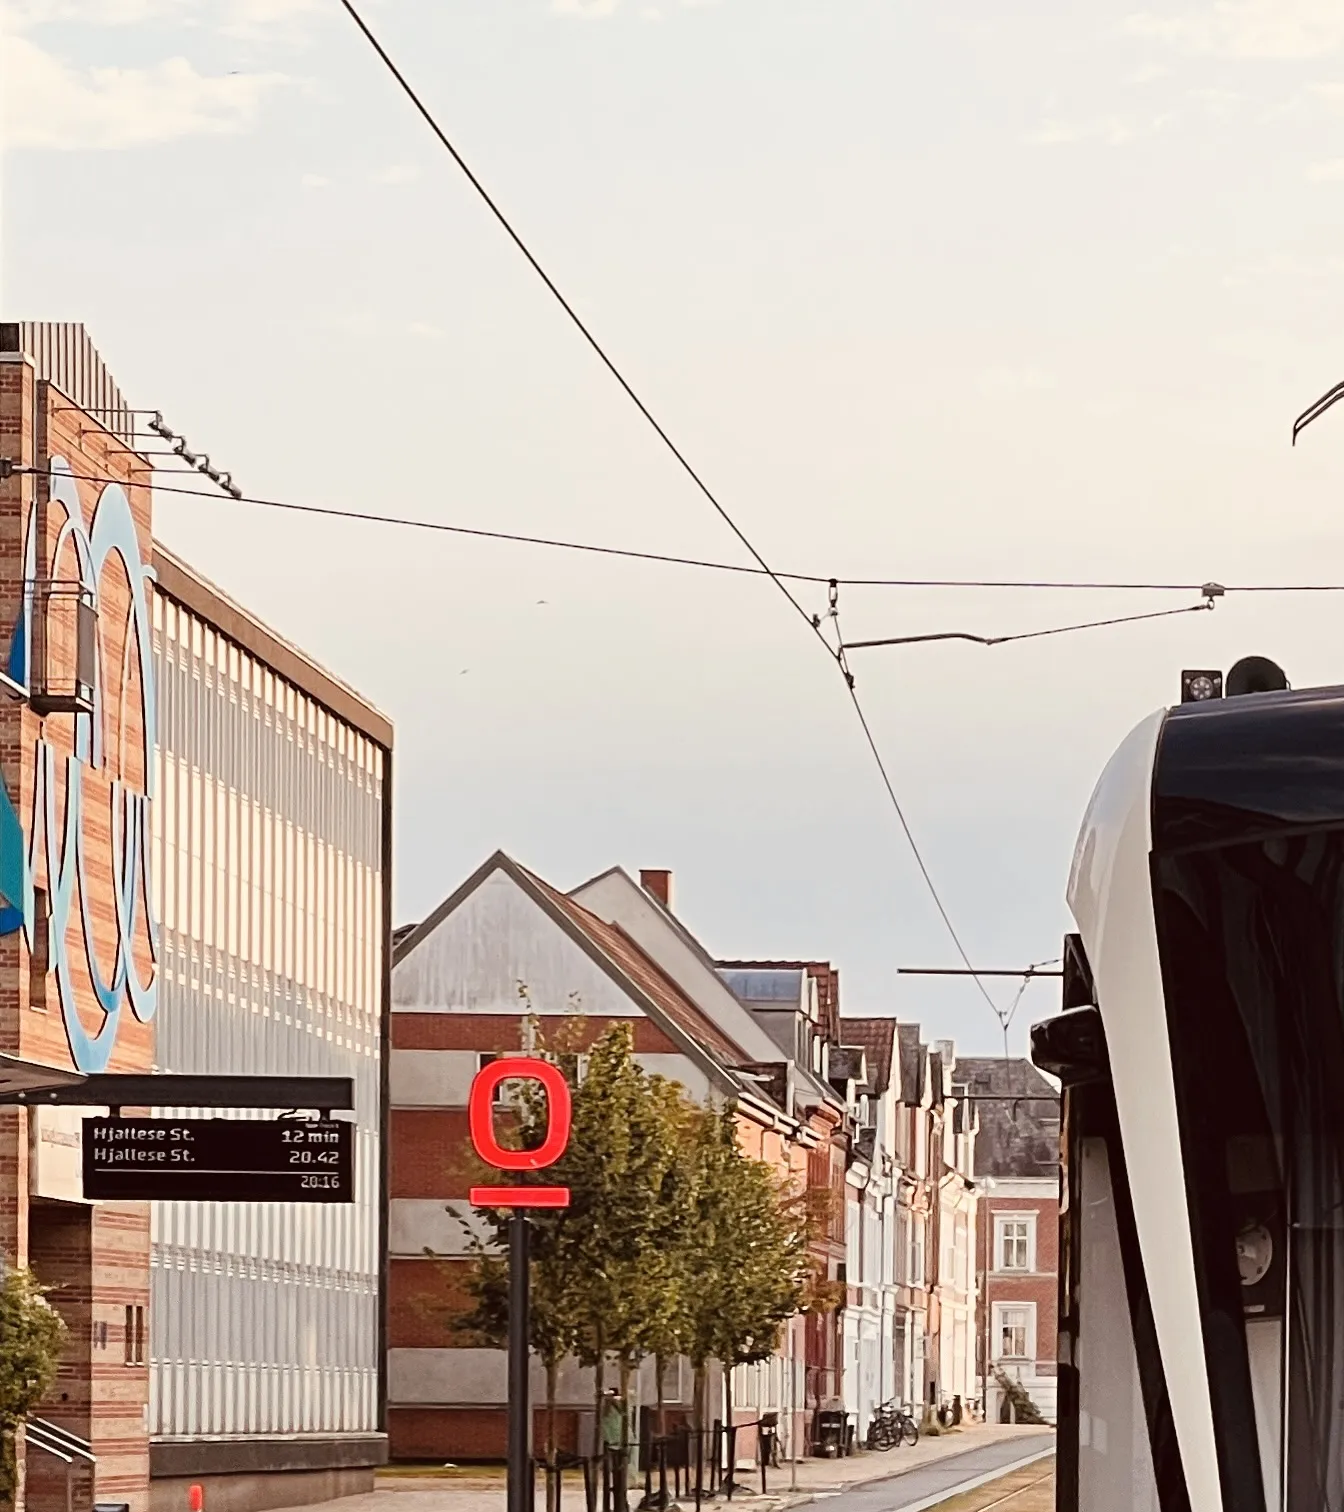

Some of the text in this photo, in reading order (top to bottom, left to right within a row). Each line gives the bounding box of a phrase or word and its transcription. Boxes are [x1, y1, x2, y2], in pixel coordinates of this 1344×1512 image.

[93, 1127, 339, 1143] Hjallese St. 12 min
[94, 1148, 339, 1164] Hjallese St. 20.42
